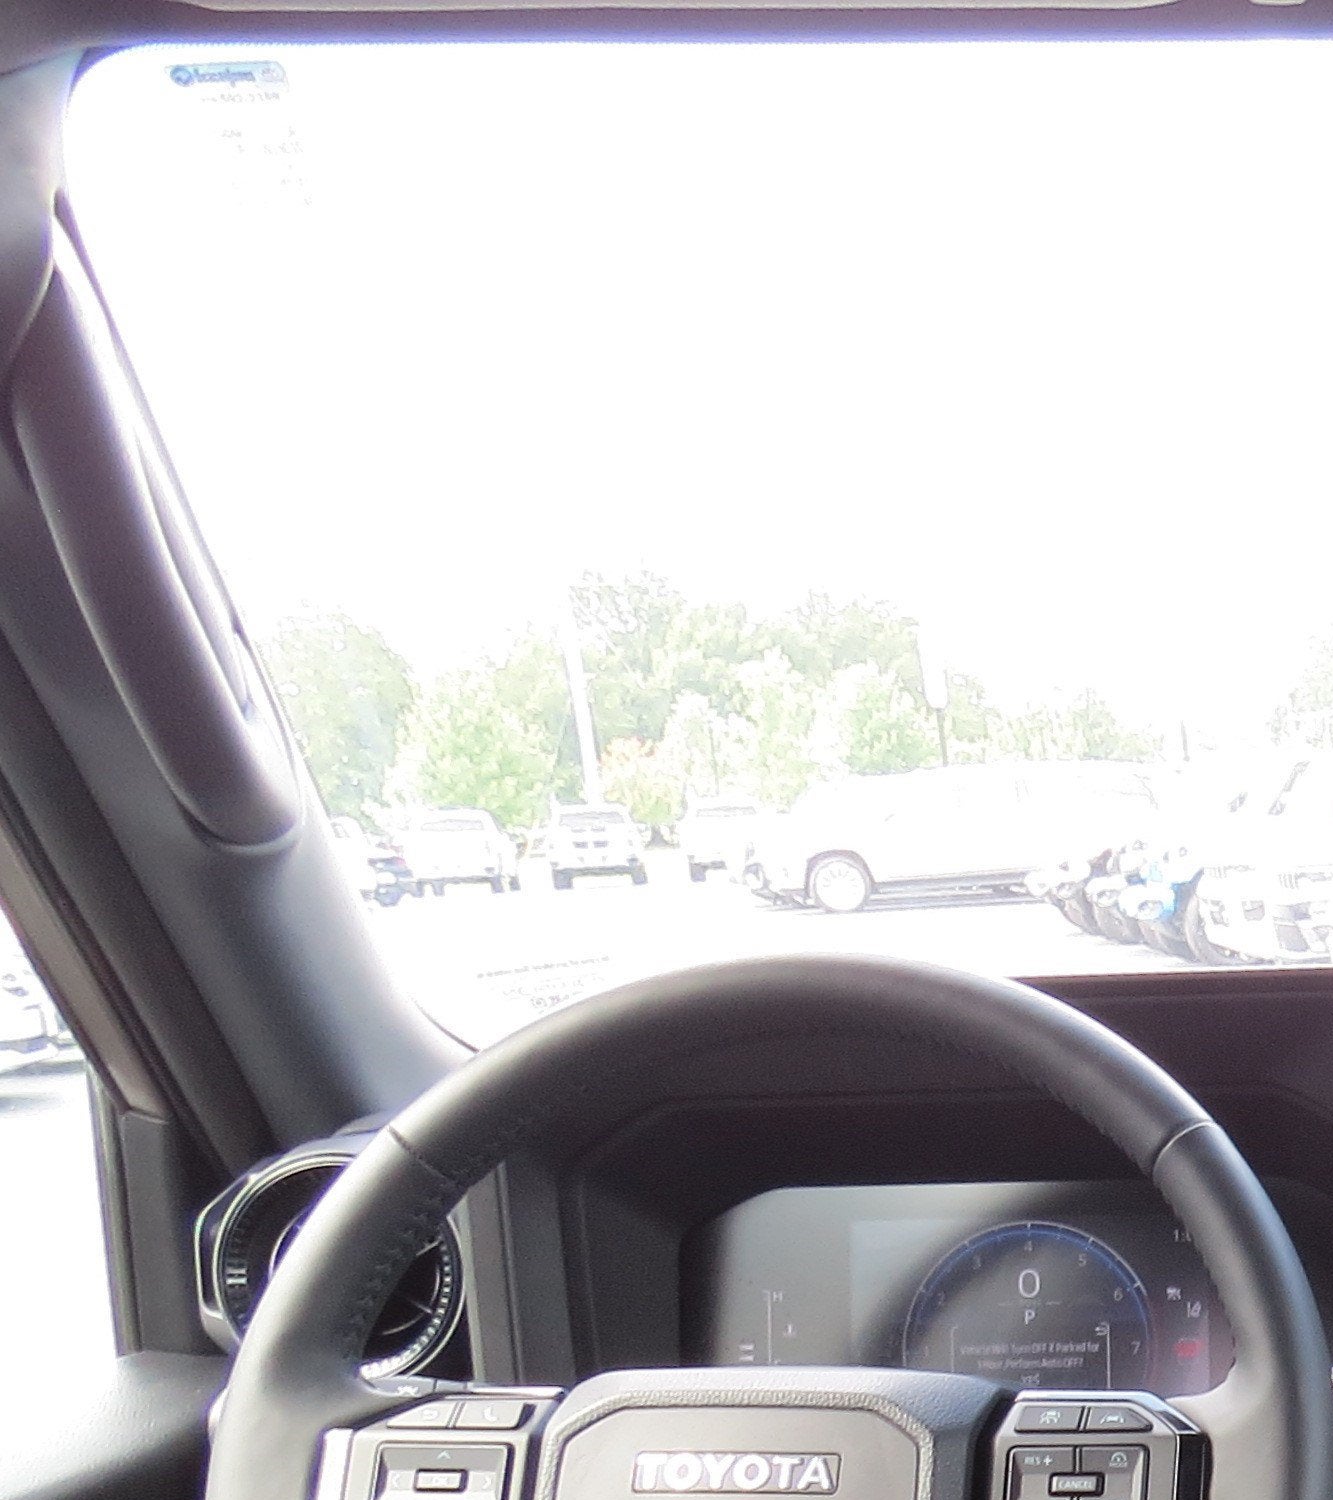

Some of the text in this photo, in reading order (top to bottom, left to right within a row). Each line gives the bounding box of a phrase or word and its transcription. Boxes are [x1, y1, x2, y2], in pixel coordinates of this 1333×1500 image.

[1024, 1309, 1036, 1325] P
[636, 1453, 834, 1491] TOYOTA
[1057, 1480, 1093, 1490] CANCEL
